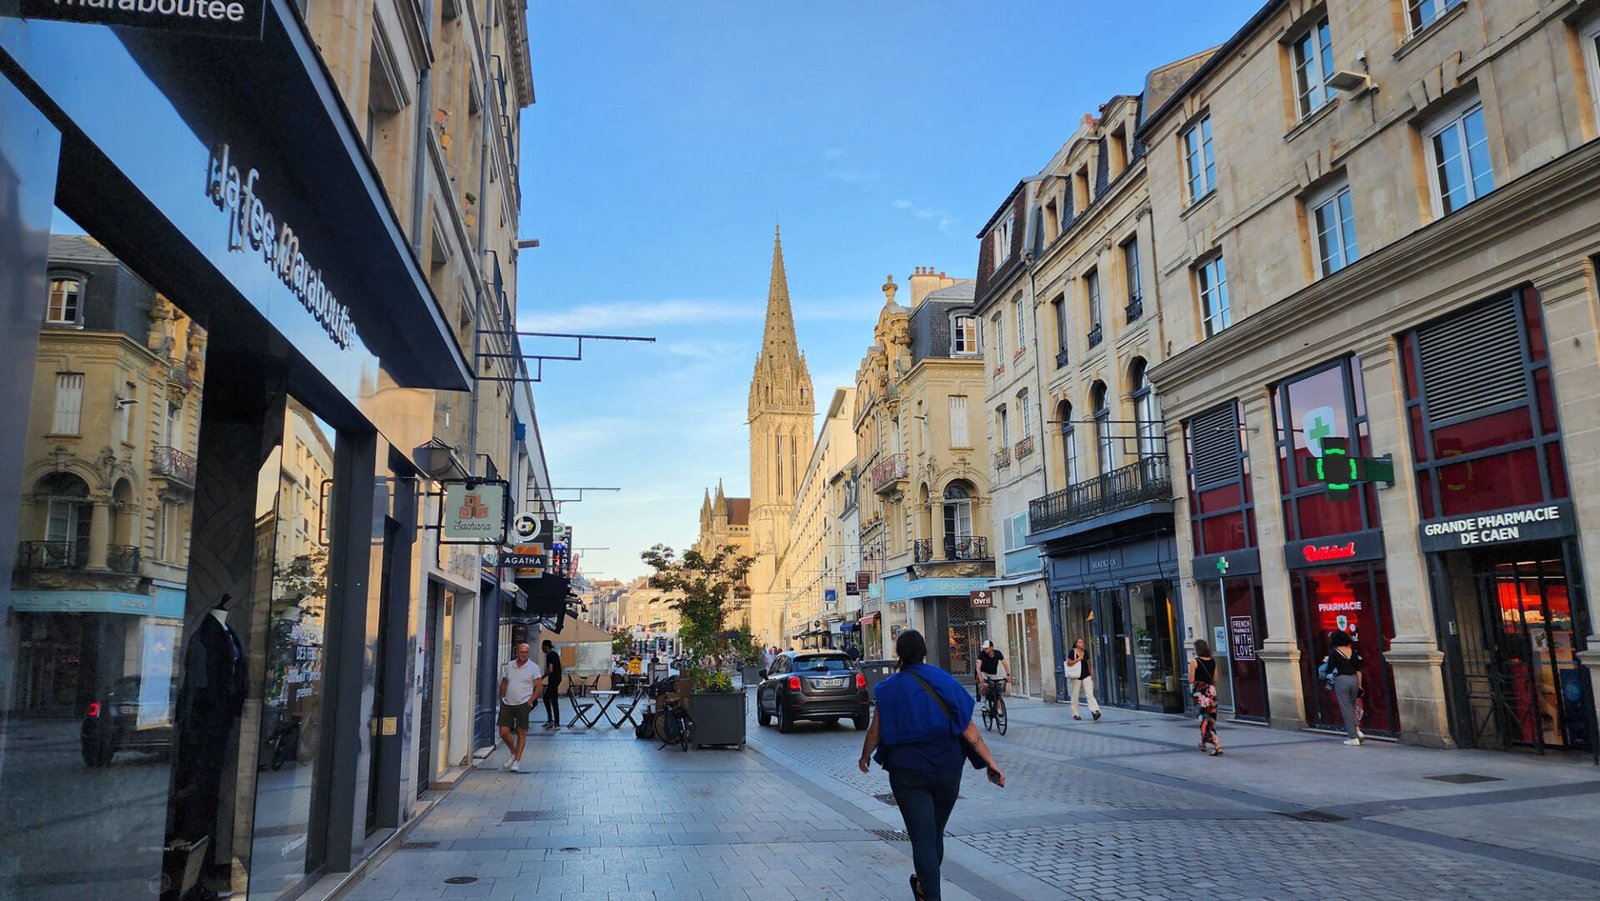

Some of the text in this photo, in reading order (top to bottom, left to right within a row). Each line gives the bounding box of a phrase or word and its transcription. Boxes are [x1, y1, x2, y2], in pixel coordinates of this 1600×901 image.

[220, 143, 240, 213] la
[1425, 506, 1560, 536] GRANDE PHARMACIE
[1460, 526, 1520, 545] DE CAEN
[504, 556, 541, 565] AGATHA
[1091, 558, 1118, 569] MADURA
[973, 597, 991, 605] avril
[1318, 601, 1362, 612] PHARMACIE
[1232, 620, 1250, 628] FRENCH
[1234, 634, 1252, 645] WITH
[1236, 645, 1253, 656] LOVE
